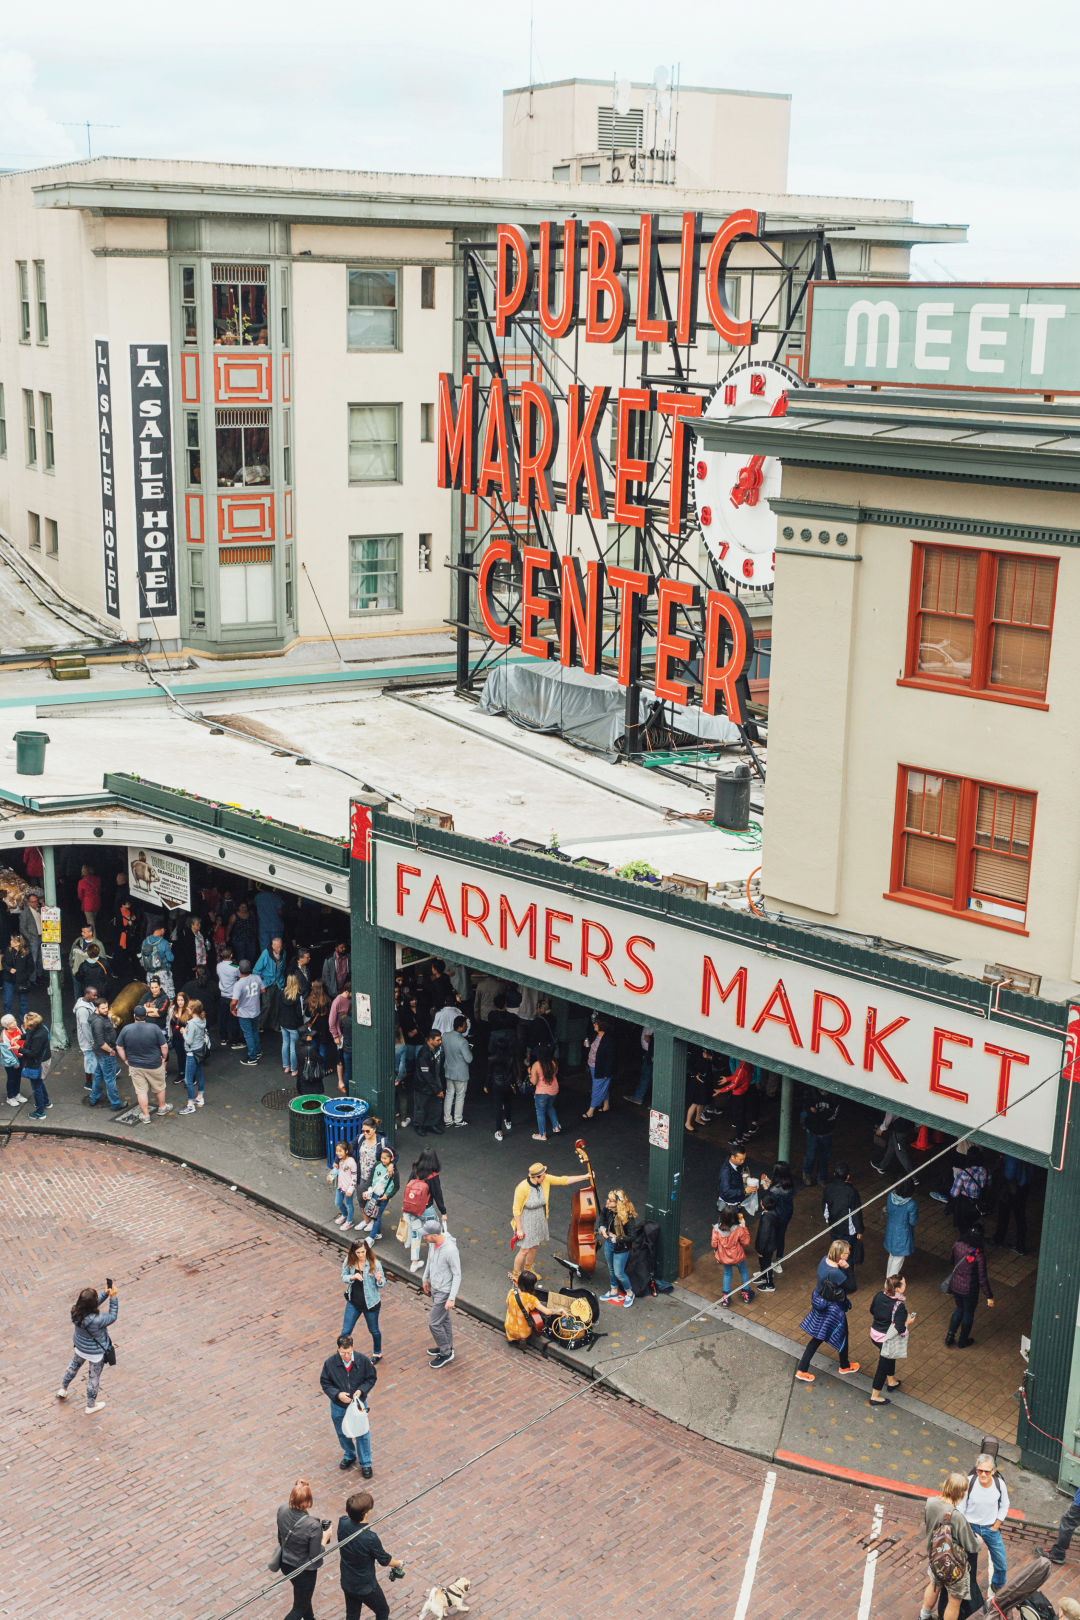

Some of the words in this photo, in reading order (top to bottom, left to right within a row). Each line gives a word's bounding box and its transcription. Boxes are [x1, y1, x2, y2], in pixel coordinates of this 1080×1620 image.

[496, 209, 764, 346] PUBLIC
[97, 345, 108, 386] LA
[843, 300, 1067, 375] MEET
[136, 348, 163, 387] LA
[724, 384, 737, 406] 11
[750, 373, 766, 396] 12
[100, 394, 113, 497] SALLE
[139, 399, 165, 499] SALLE
[437, 372, 703, 536] MARKET
[696, 460, 707, 480] 9
[700, 505, 712, 526] 8
[104, 508, 117, 610] HOTEL
[142, 510, 169, 609] HOTEL
[718, 541, 730, 560] 7
[742, 558, 754, 578] 6
[477, 539, 753, 725] CENTER
[246, 982, 259, 998] 12
[396, 862, 656, 995] FARMERS
[700, 955, 1030, 1117] MARKET
